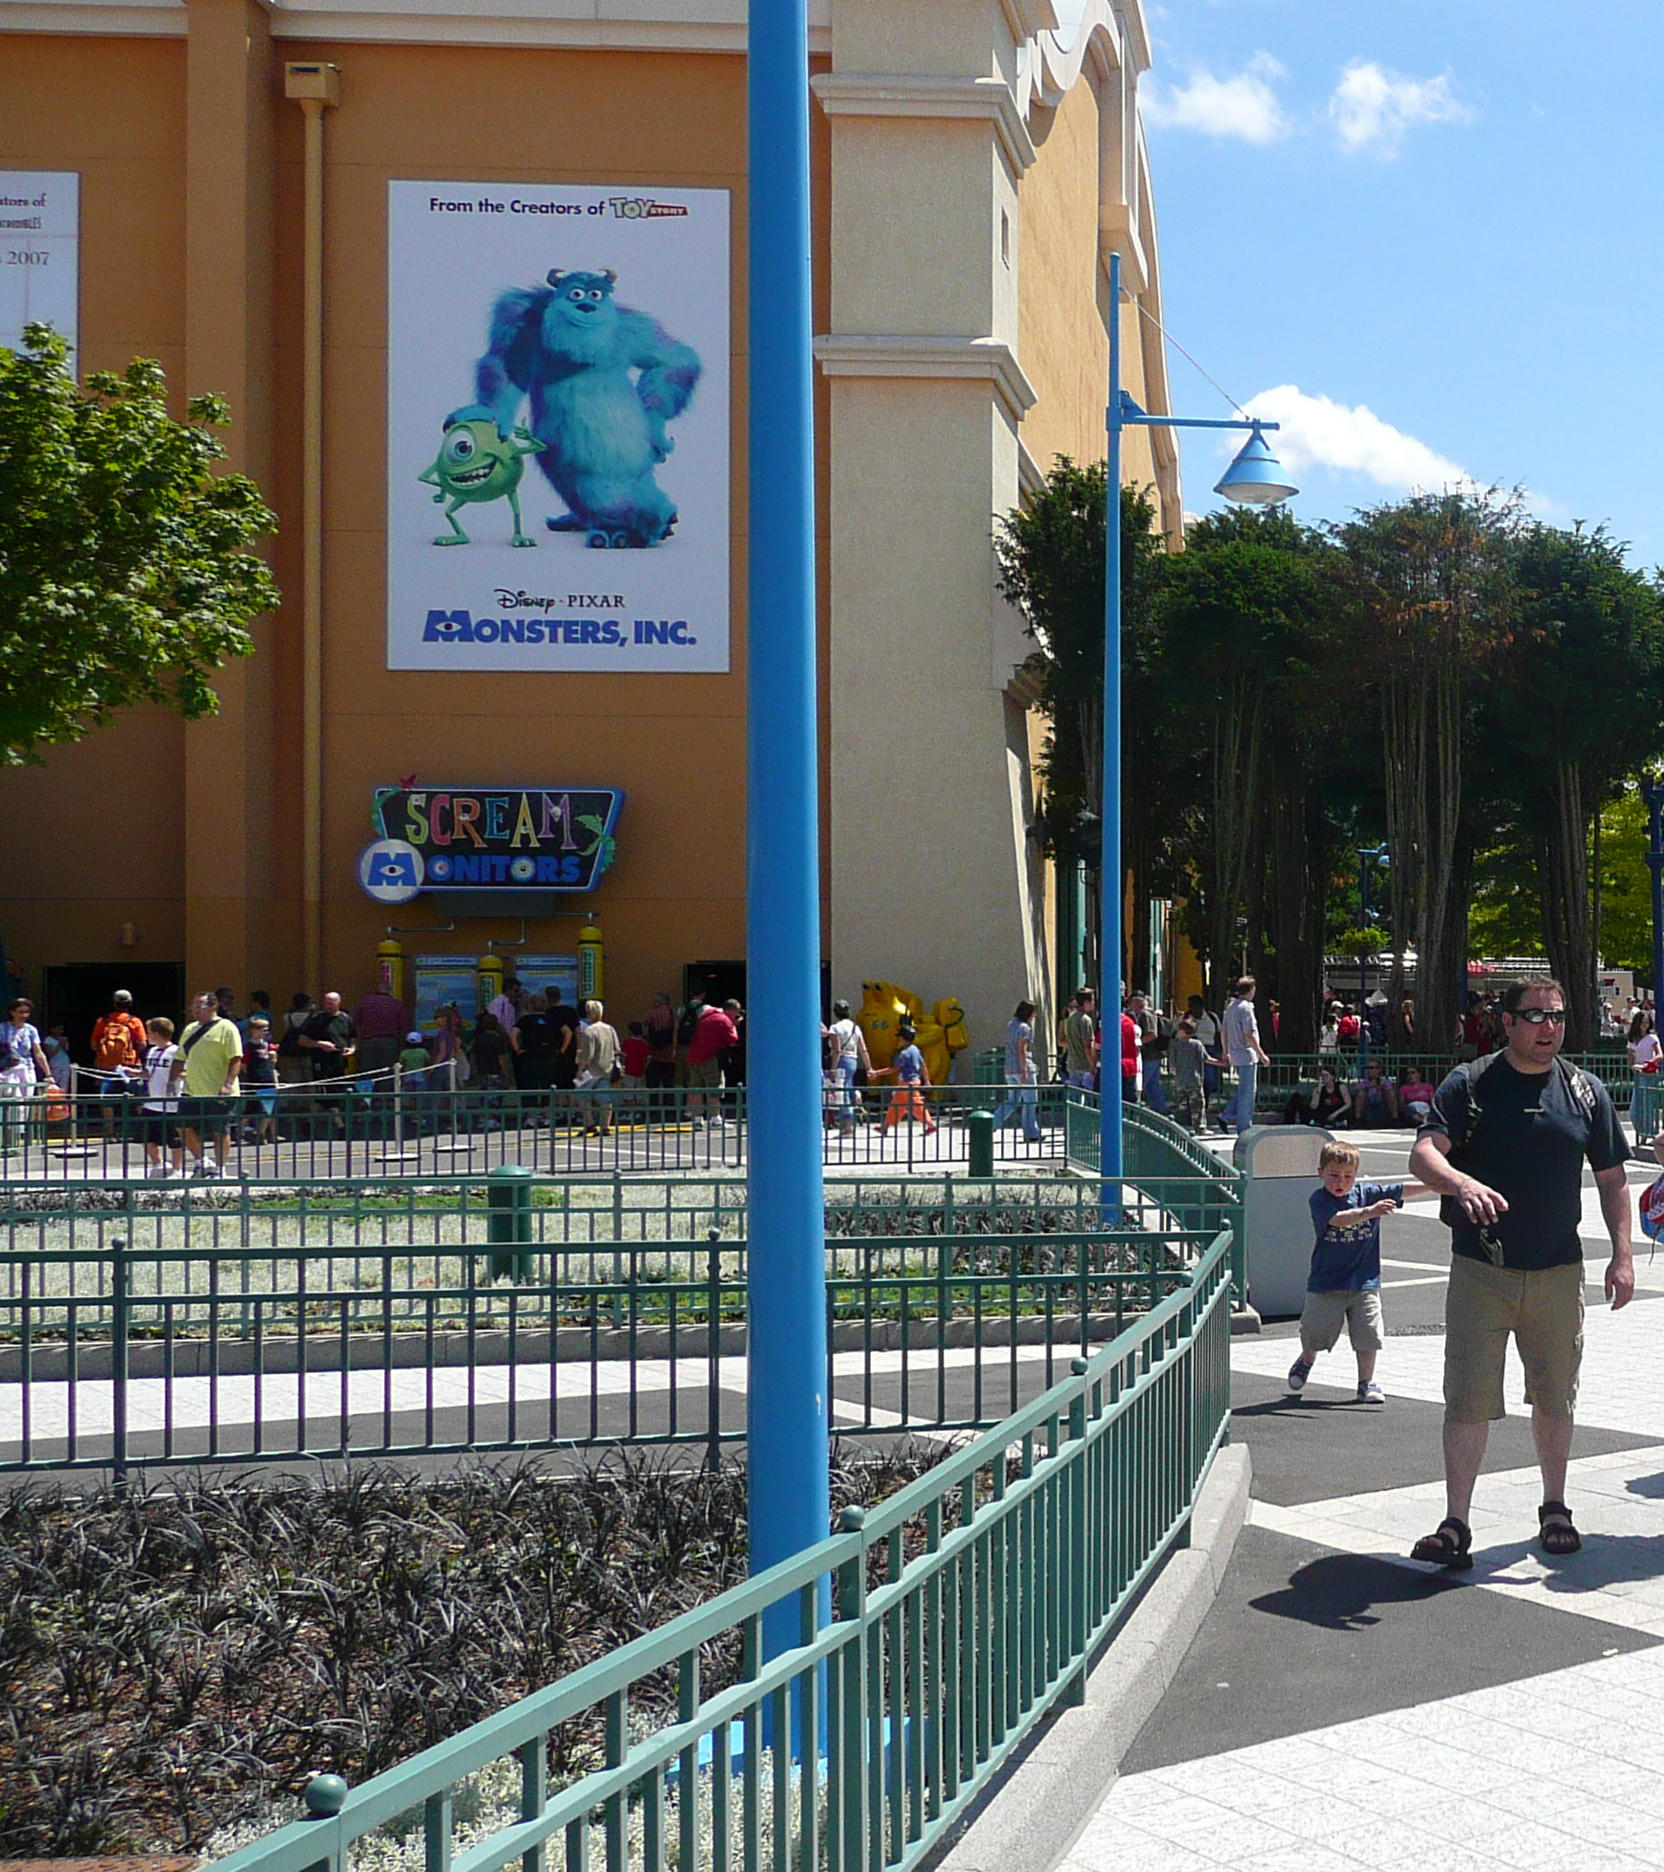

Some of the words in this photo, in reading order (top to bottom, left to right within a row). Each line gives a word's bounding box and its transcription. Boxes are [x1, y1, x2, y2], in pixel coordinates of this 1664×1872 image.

[32, 192, 46, 207] of
[429, 198, 473, 213] From
[478, 198, 505, 213] the
[510, 199, 582, 215] Creators
[587, 201, 606, 216] of
[608, 197, 653, 219] TOY
[650, 206, 686, 216] STORY
[7, 250, 51, 265] 2007
[567, 595, 626, 608] PIXAR
[634, 619, 698, 645] INC.
[404, 791, 578, 850] SCREAM
